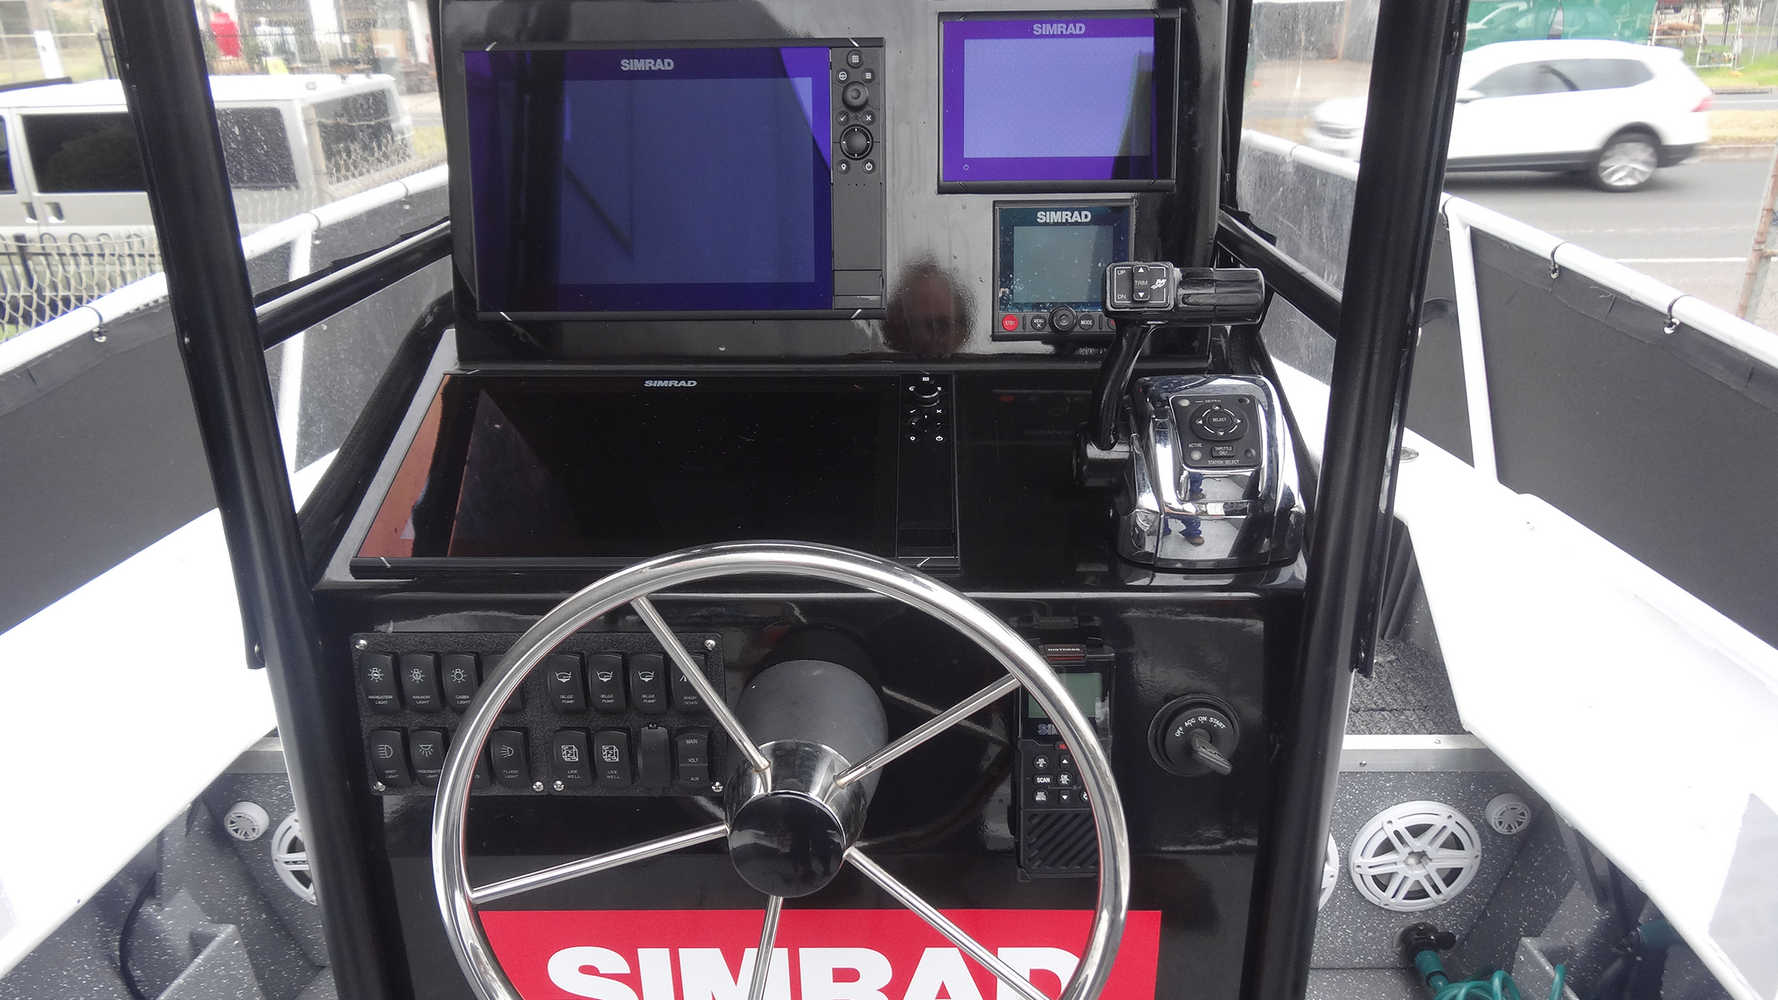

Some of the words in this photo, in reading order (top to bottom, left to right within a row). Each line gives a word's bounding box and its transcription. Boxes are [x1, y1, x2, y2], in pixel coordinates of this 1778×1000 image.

[1033, 23, 1086, 35] SIMRAD
[620, 58, 674, 71] SIMRAD
[1036, 210, 1092, 223] SIMRAD
[643, 379, 698, 388] SIMRAD
[1174, 726, 1184, 737] OFF
[1184, 717, 1196, 727] ACC
[1209, 717, 1226, 728] START
